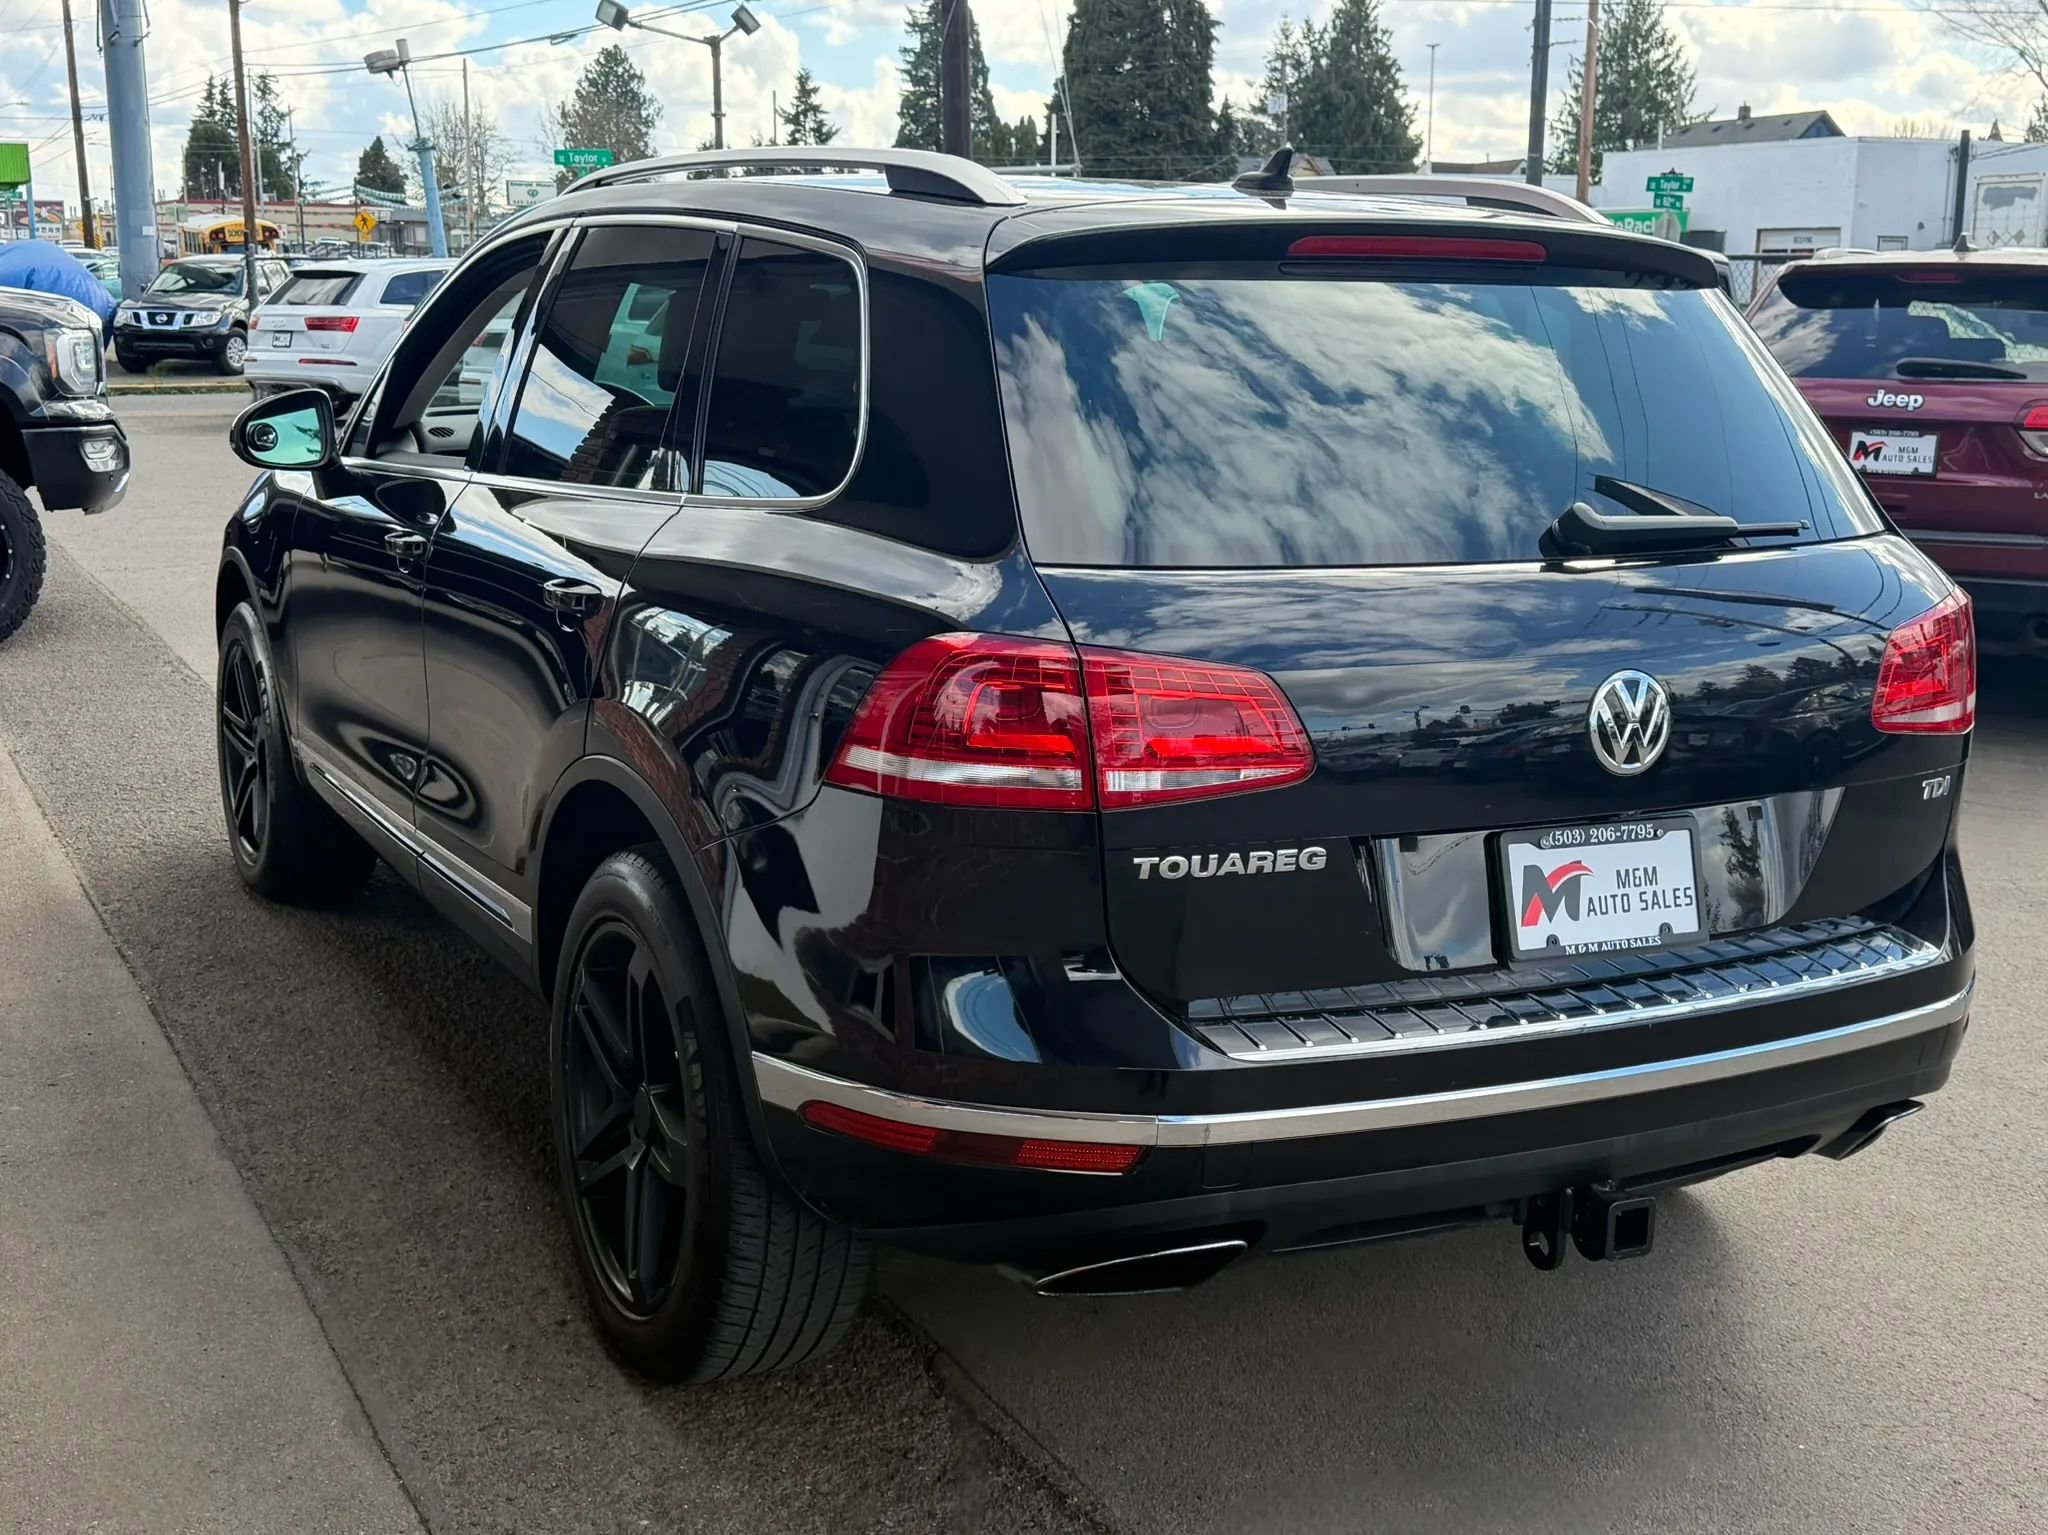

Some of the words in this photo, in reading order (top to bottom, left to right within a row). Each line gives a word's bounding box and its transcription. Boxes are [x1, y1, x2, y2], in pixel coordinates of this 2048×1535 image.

[568, 152, 598, 165] Taylor
[1867, 389, 1924, 411] Jeep
[1882, 454, 1903, 463] AUTO
[1906, 455, 1933, 464] SALES
[1922, 775, 1950, 800] TDI
[1549, 828, 1585, 847] (503)
[1589, 824, 1655, 844] 206-7795
[1133, 846, 1327, 880] TOUAREG
[1616, 866, 1659, 889] M&M
[1587, 893, 1631, 917] AUTO
[1640, 887, 1693, 911] SALES
[1565, 945, 1576, 955] M
[1578, 944, 1587, 953] &
[1588, 942, 1599, 952] M
[1601, 940, 1628, 951] AUTO
[1630, 936, 1661, 949] SALES
